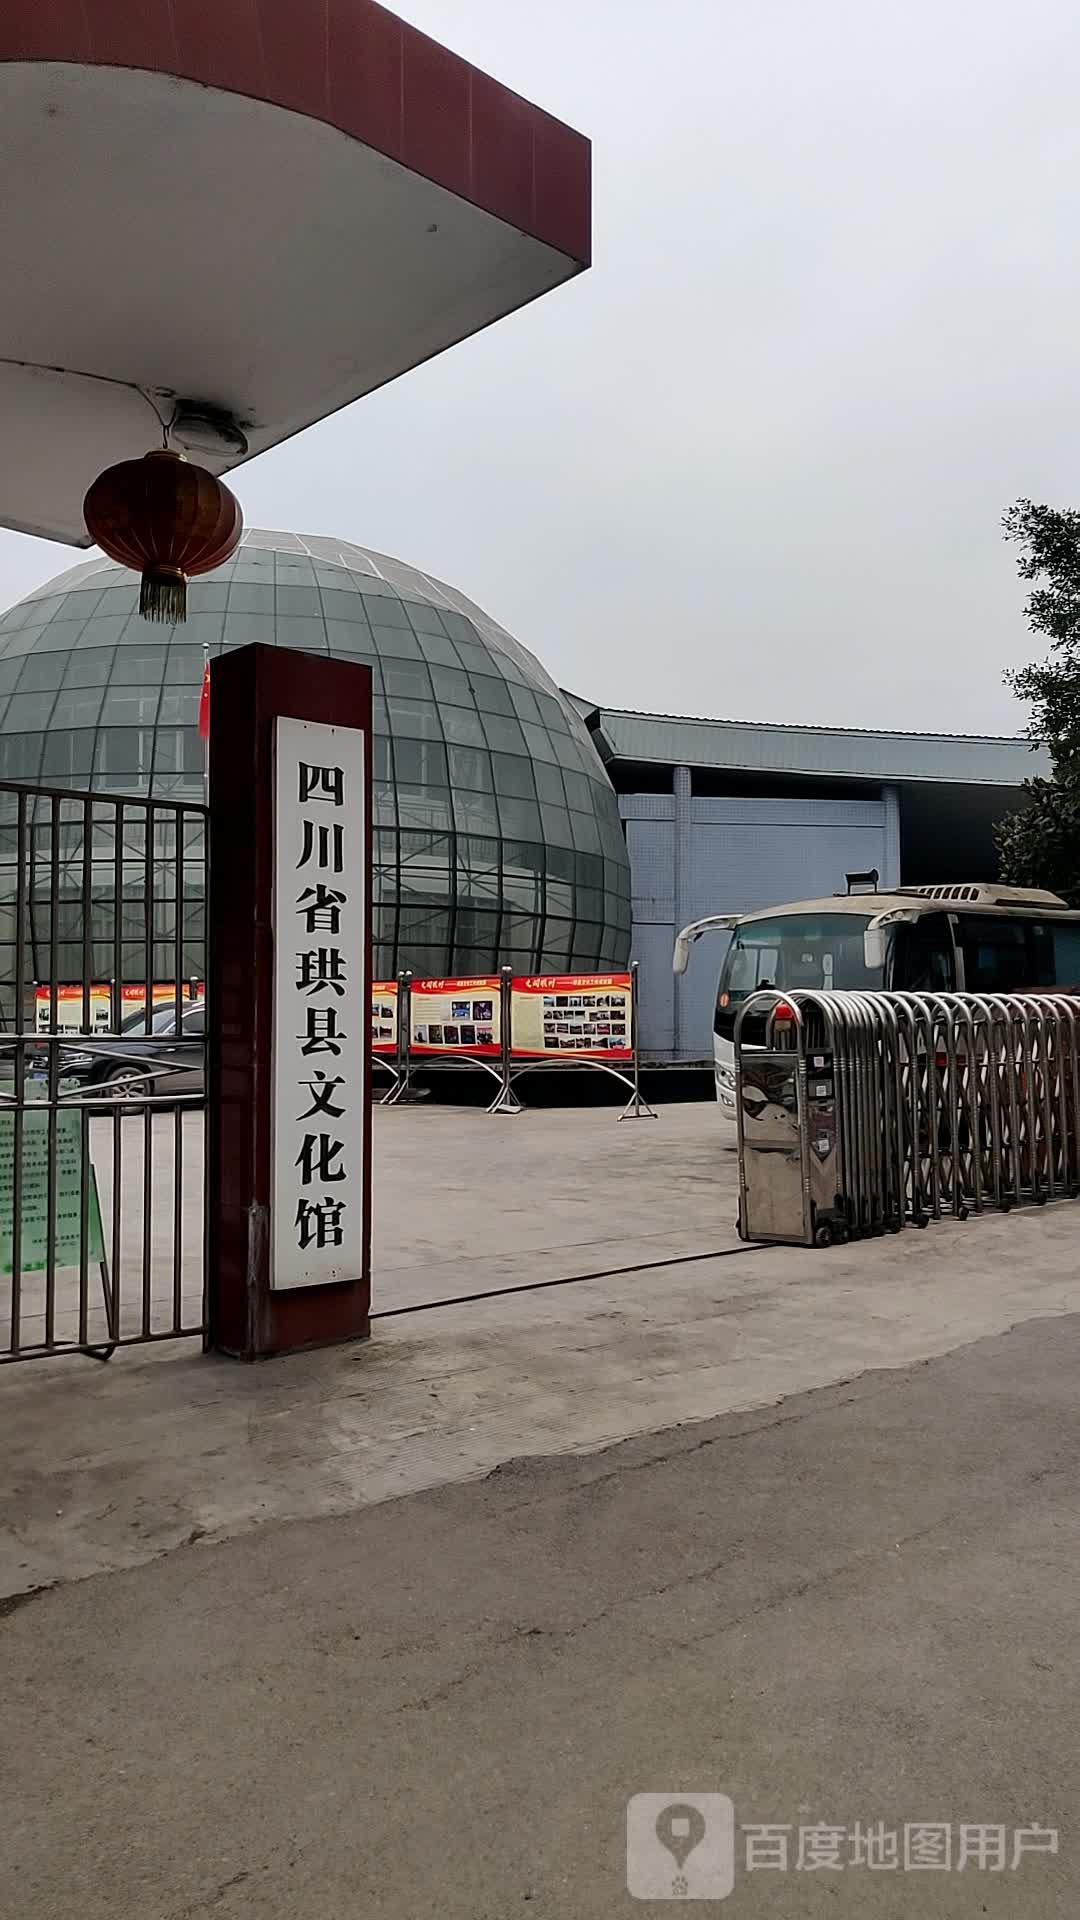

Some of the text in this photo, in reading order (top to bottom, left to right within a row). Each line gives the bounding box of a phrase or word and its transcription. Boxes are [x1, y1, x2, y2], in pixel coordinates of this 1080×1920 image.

[295, 762, 347, 1249] 四川省珙县文化馆
